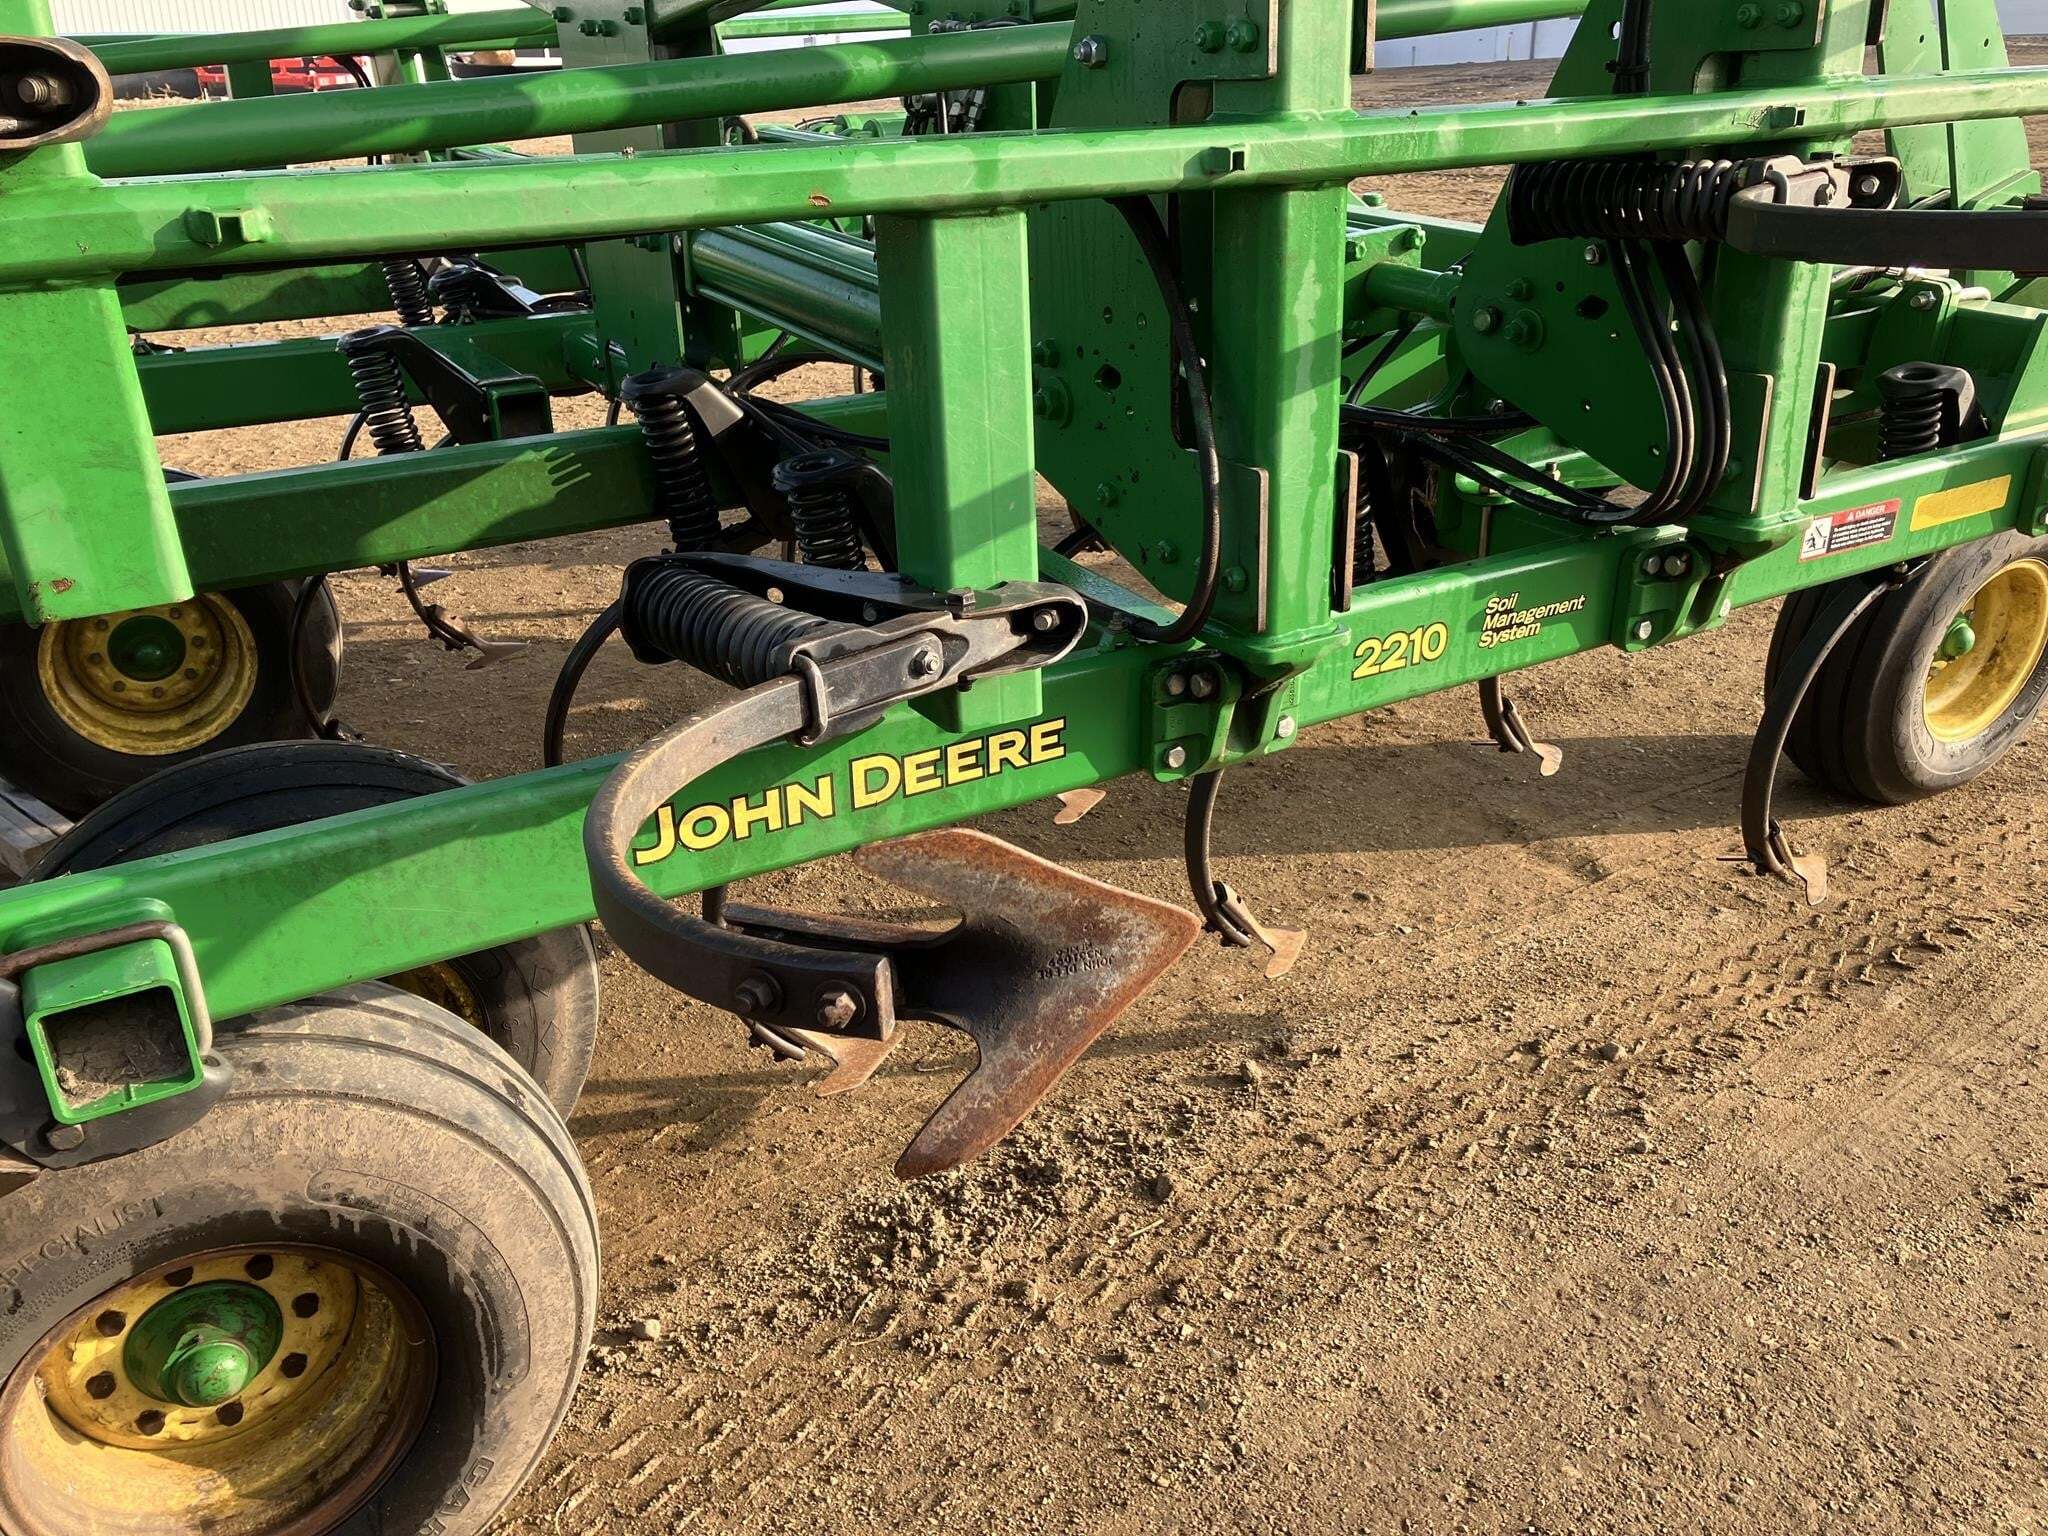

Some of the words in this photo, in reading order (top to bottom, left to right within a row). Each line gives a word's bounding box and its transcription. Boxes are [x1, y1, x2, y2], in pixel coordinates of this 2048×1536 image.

[1855, 504, 1887, 520] DANGER
[1482, 594, 1586, 631] Management
[1485, 592, 1520, 615] Soil
[1352, 621, 1449, 680] 2210
[1478, 622, 1542, 649] System
[632, 771, 835, 867] JOHN
[849, 717, 1068, 810] DEERE
